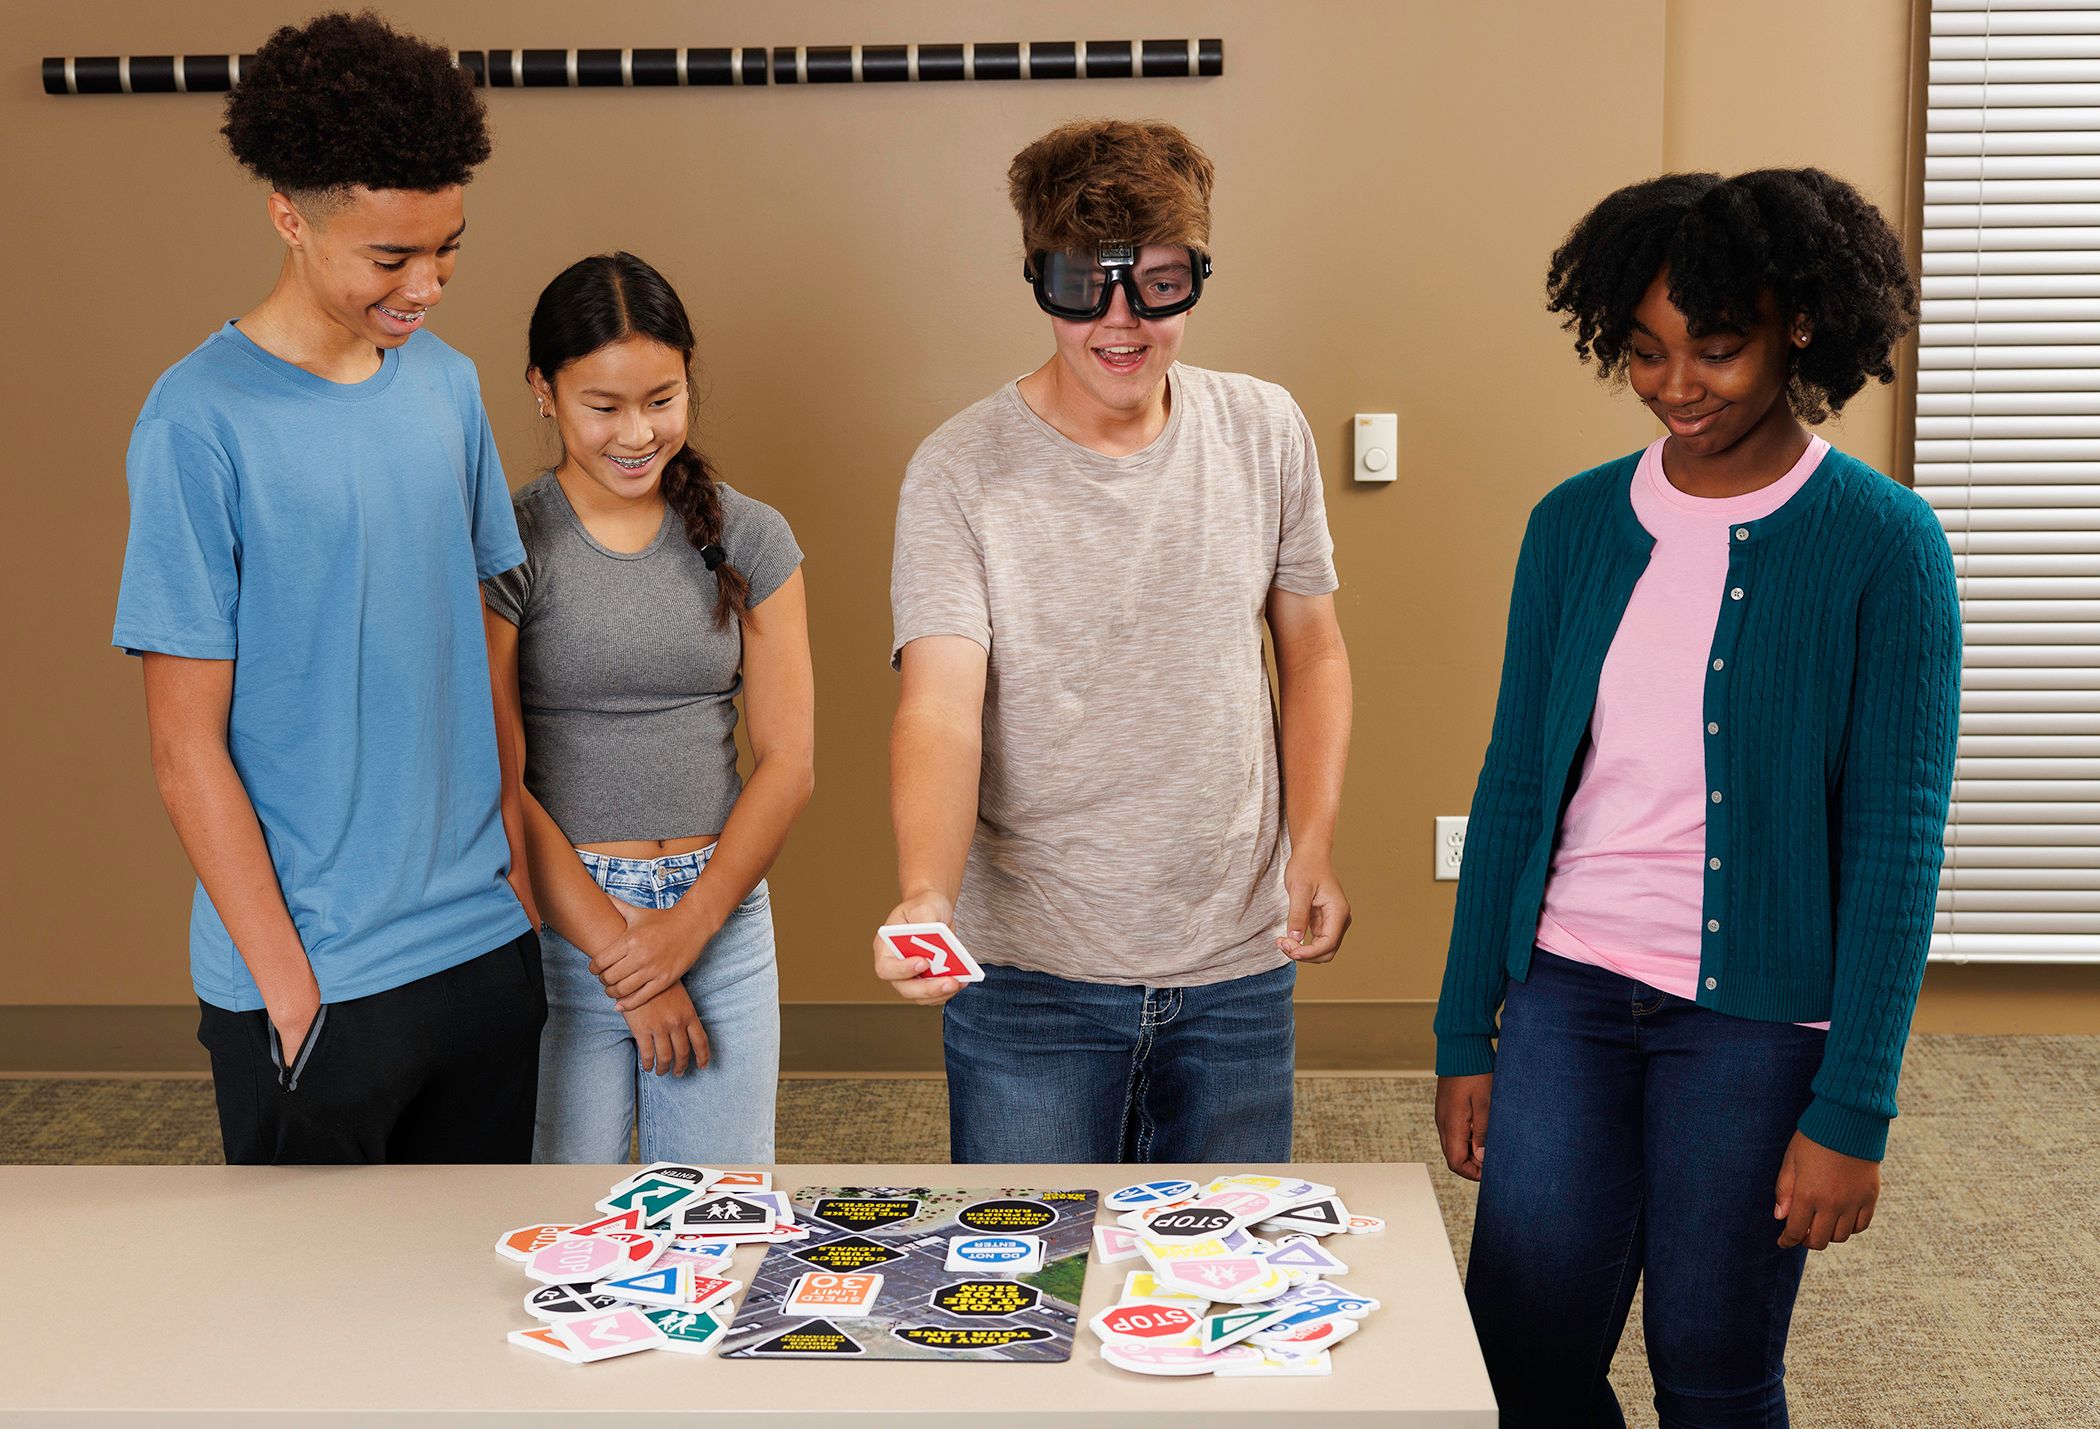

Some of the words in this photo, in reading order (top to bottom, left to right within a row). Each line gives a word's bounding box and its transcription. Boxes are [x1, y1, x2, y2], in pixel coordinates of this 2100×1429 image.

[660, 1169, 697, 1181] ENTER
[1154, 1215, 1230, 1229] STOP
[558, 1240, 595, 1272] STOP
[810, 1275, 868, 1289] 30
[800, 1295, 862, 1303] SPEED
[942, 1297, 993, 1305] THE
[951, 1304, 1017, 1312] STOP
[1112, 1310, 1190, 1331] STOP
[908, 1330, 967, 1338] LANE
